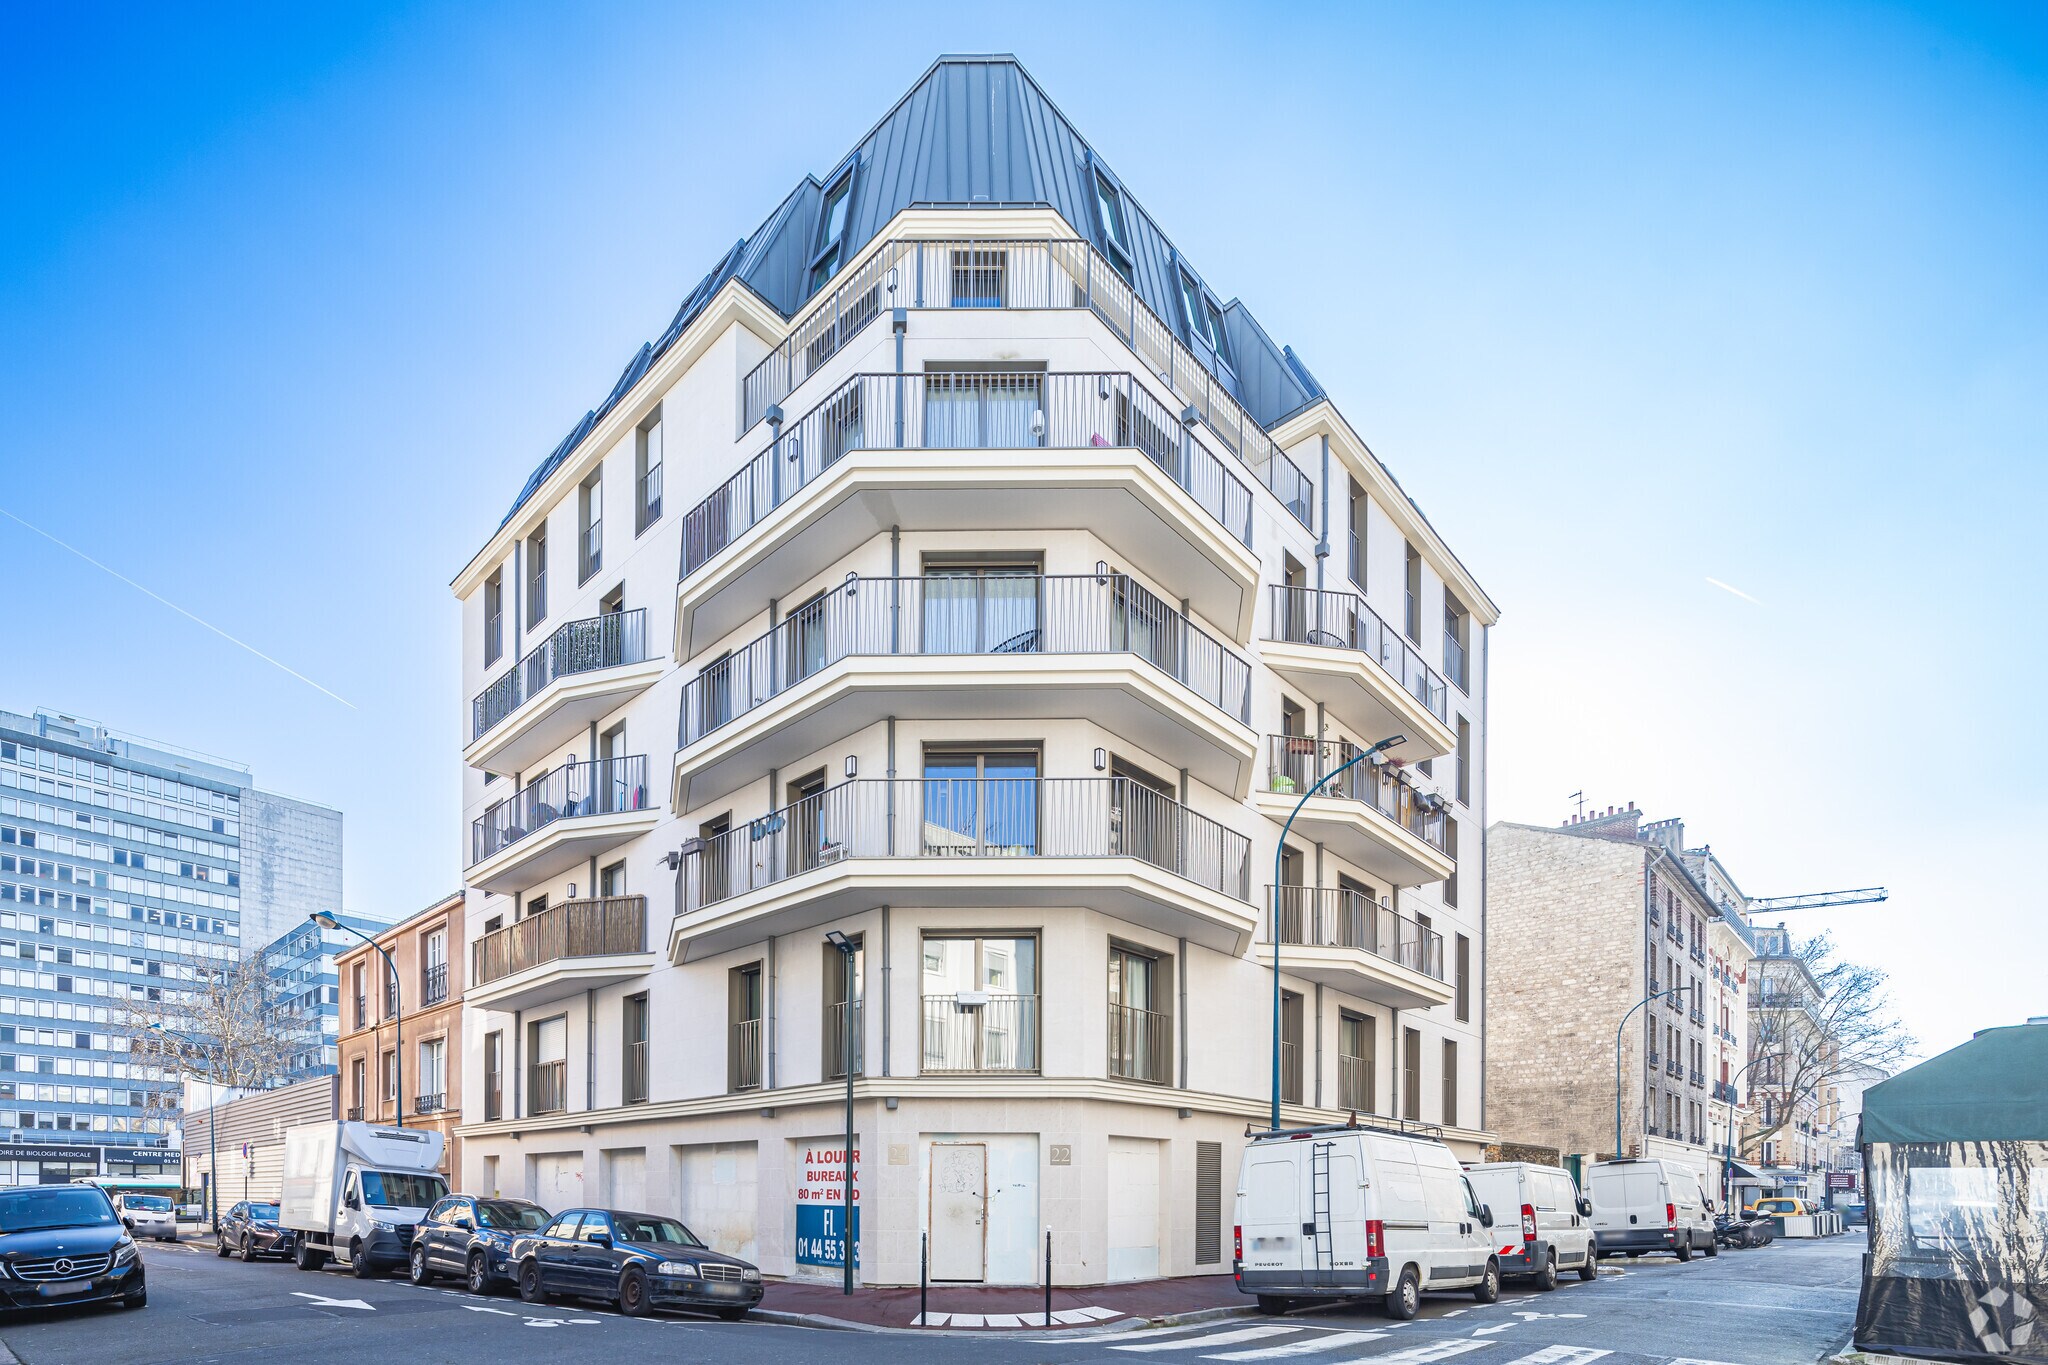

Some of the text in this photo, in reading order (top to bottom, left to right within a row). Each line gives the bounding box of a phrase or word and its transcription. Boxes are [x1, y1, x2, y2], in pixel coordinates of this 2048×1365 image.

[805, 1148, 860, 1164] À LOUR
[1051, 1147, 1070, 1162] 22
[798, 1188, 809, 1200] 80
[826, 1189, 841, 1200] EN
[798, 1237, 808, 1257] 01
[811, 1238, 822, 1258] 44
[825, 1239, 836, 1260] 55
